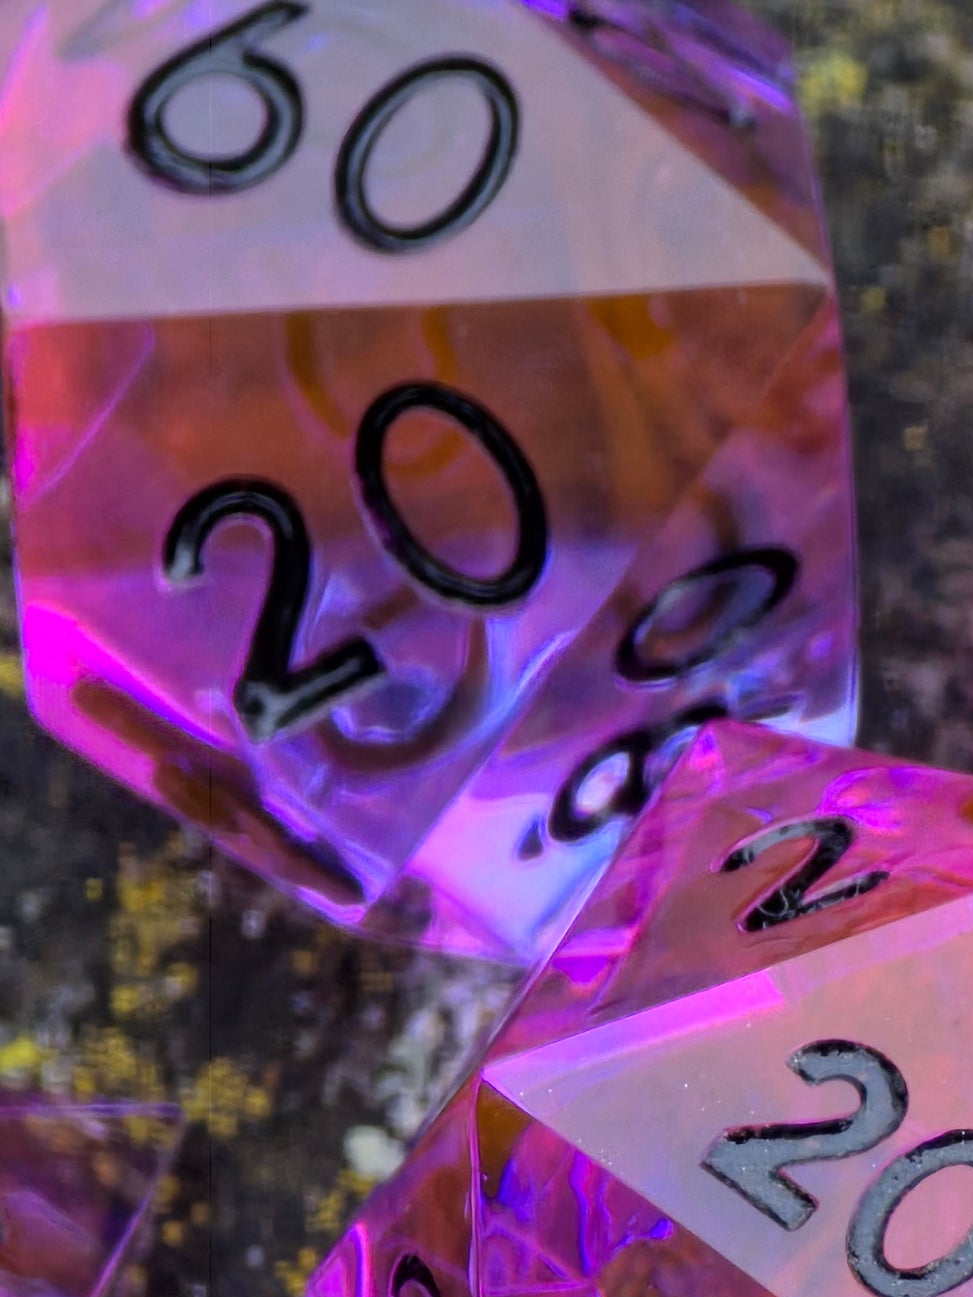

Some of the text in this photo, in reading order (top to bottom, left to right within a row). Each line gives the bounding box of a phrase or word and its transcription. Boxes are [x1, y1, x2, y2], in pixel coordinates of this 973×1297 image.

[123, 0, 519, 254] 60
[163, 380, 550, 743] 20
[716, 814, 891, 933] 2
